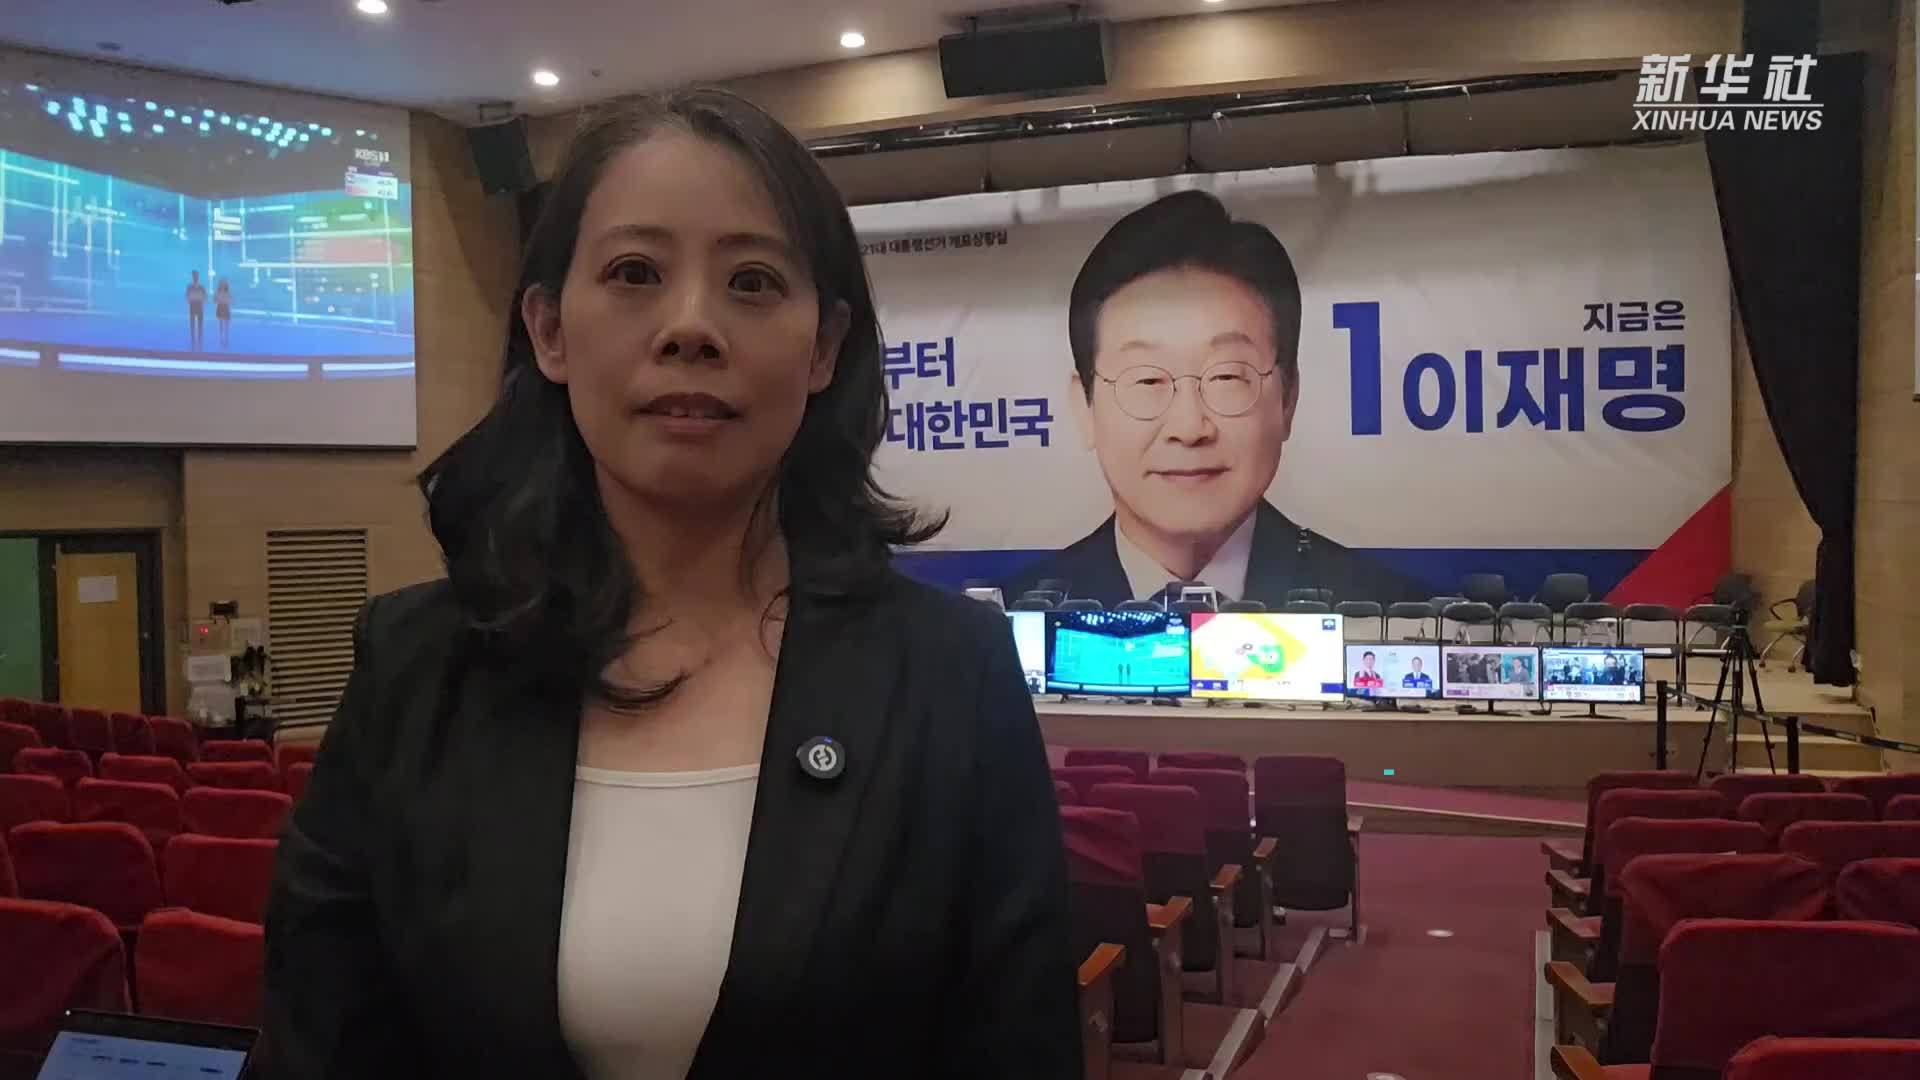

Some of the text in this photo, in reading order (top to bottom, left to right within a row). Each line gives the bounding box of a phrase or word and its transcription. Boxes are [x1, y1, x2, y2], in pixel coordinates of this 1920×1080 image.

[1583, 300, 1686, 333] 지금은
[1332, 301, 1686, 436] 1 이재명
[886, 398, 1055, 451] 대한민국
